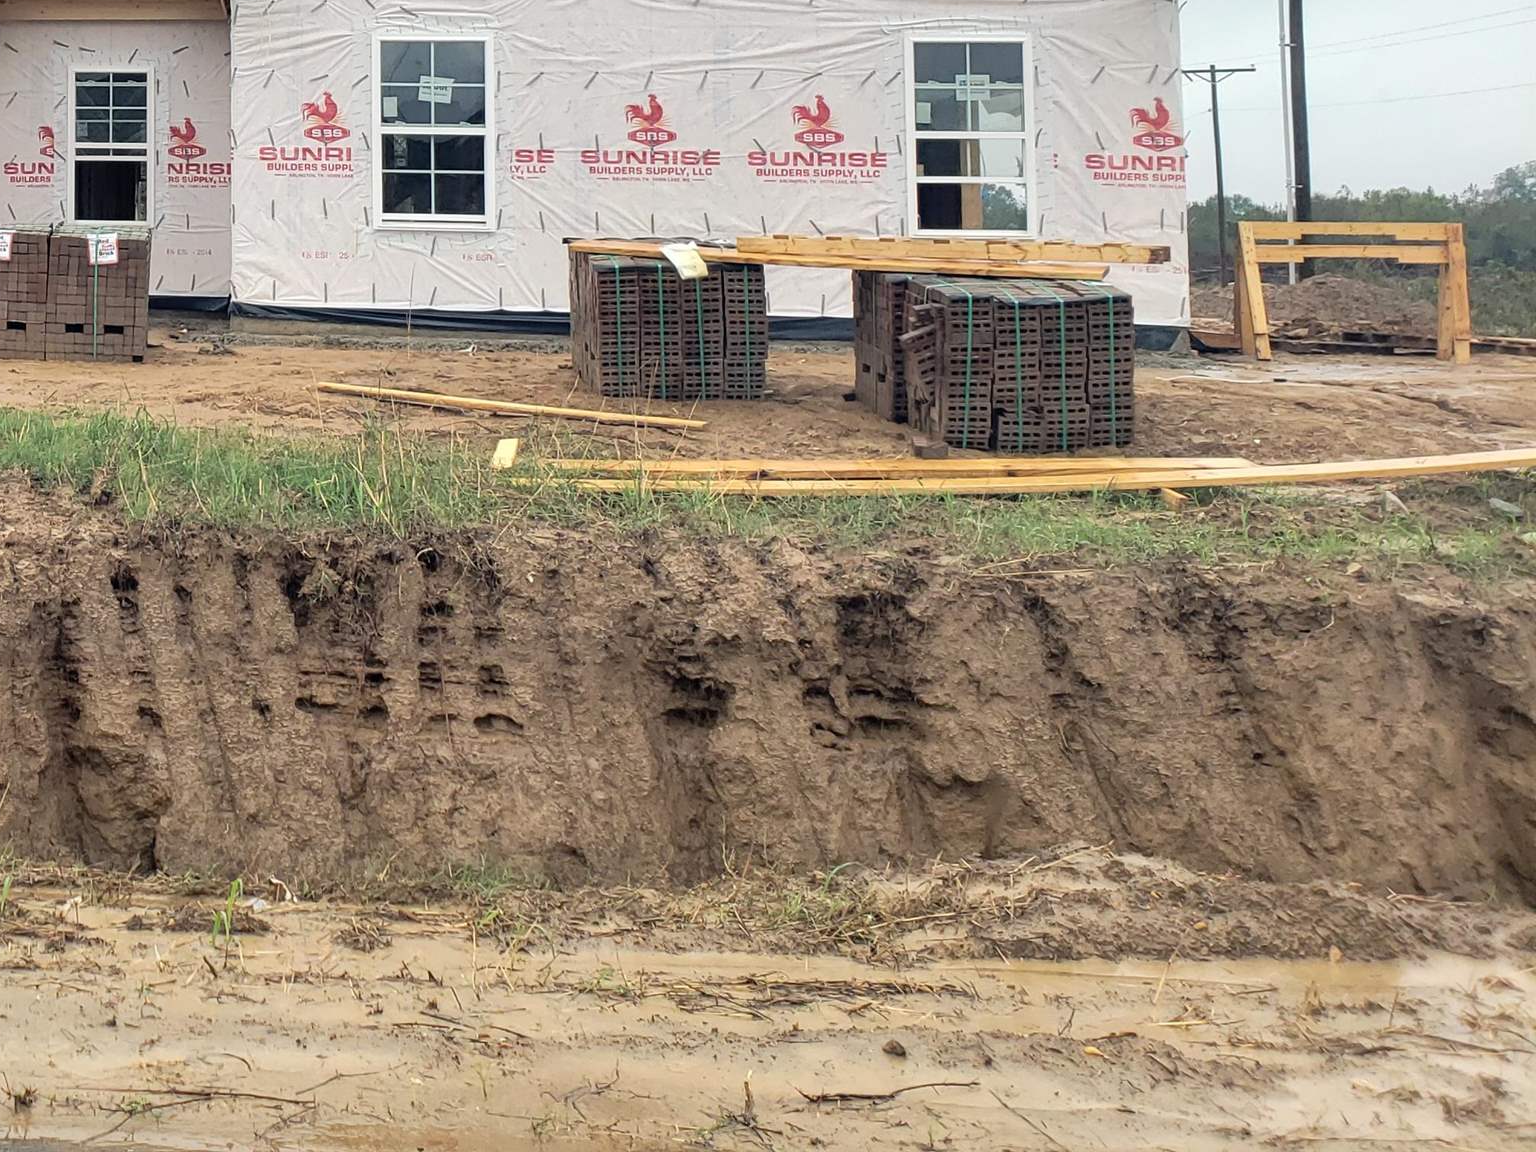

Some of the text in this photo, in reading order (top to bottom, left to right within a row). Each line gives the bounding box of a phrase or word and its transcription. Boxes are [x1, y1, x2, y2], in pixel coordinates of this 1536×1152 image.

[312, 128, 342, 138] SBS
[636, 132, 669, 141] SBS
[803, 133, 836, 143] SBS
[1141, 136, 1175, 146] SBS
[174, 148, 200, 156] SBS
[259, 146, 351, 161] SUNRI
[514, 149, 555, 163] SE
[580, 149, 721, 165] SUNRISE
[747, 151, 888, 168] SUNRISE
[1084, 153, 1185, 171] SUNRI
[267, 162, 318, 172] BUILDERS
[527, 165, 547, 174] LLC
[589, 166, 713, 177] BUILDERS SUPPLY, LLC
[10, 175, 51, 183] BUILDERS
[756, 168, 881, 180] BUILDERS SUPPLY, LLC
[1093, 171, 1149, 181] BUILDERS
[182, 175, 218, 184] SUPPLY,
